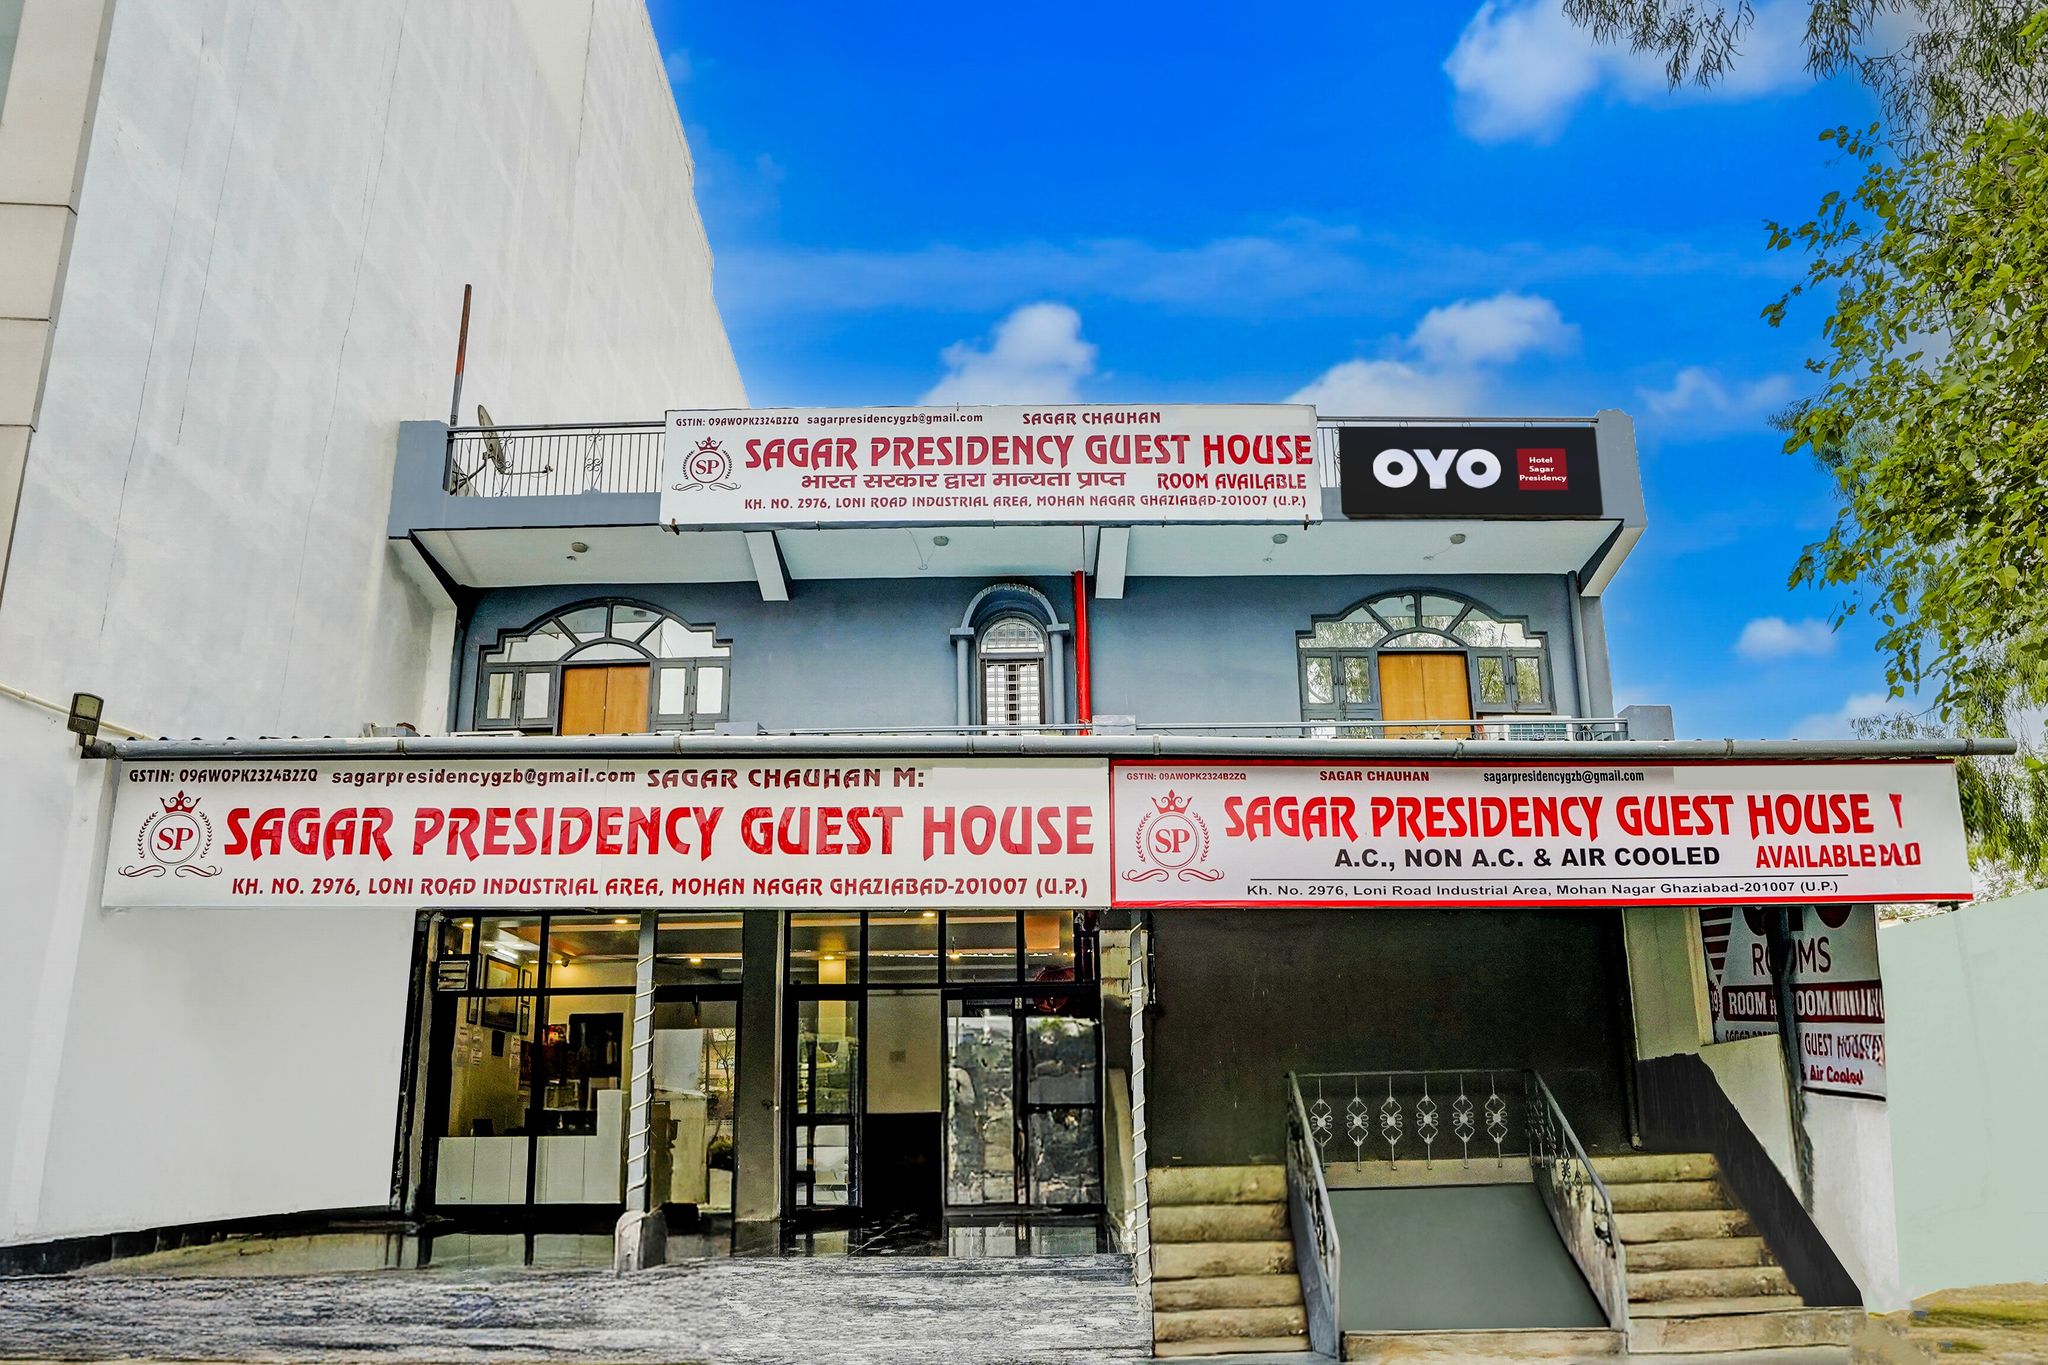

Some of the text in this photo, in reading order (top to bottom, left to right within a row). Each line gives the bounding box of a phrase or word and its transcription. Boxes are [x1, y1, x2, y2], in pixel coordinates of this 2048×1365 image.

[808, 413, 982, 426] sagarpresidencygzb@gmail.com
[1023, 412, 1160, 425] SAGAR CHAUHAN
[746, 435, 1313, 471] SAGAR PRESIDENCY GUEST HOUSE
[1529, 456, 1553, 464] Hotel
[695, 459, 719, 475] SP
[1372, 448, 1501, 489] OYO
[1529, 466, 1554, 474] Sagar
[802, 473, 1126, 489] भारत सरकार द्वारा मान्यता प्राप्त
[1158, 473, 1306, 490] ROOM AVAILABLE
[1519, 474, 1567, 483] Presidency
[745, 495, 1306, 510] KH. NO. 2976, LONI ROAD INDUSTRIAL AREA, MOHAN NAGAR GHAZIABAD-201007 (U.P.)
[129, 770, 174, 782] GSTIN:
[332, 767, 635, 785] sagarpresidencygzb@gmail.com
[648, 769, 737, 789] SAGAR
[748, 769, 880, 789] CHAUHAN
[1320, 771, 1429, 781] SAGAR CHAUHAN
[1484, 770, 1644, 784] sagarpresidencygzb@gmail.com
[1225, 797, 1358, 842] SAGAR
[1371, 797, 1602, 842] PRESIDENCY
[1616, 795, 1734, 836] GUEST
[1747, 794, 1874, 841] HOUSE
[156, 828, 193, 851] SP
[224, 805, 1094, 861] SAGAR PRESIDENCY GUEST HOUSE
[1154, 829, 1190, 853] SP
[1335, 847, 1719, 871] A.C., NON A.C. & AIR COOLED
[232, 878, 1087, 898] KH. NO. 2976, LONI ROAD INDUSTRIAL AREA, MOHAN NAGAR GHAZIABAD-201007 (U.P.)
[1247, 881, 1839, 898] Kh. No. 2976, Loni Road Industrial Area, Mohan Nagar Ghaziabad-201007 (U.P.)
[1751, 936, 1832, 976] RMS
[1728, 990, 1768, 1016] ROOM
[1804, 1032, 1833, 1057] GUEST
[1809, 1065, 1824, 1081] Air
